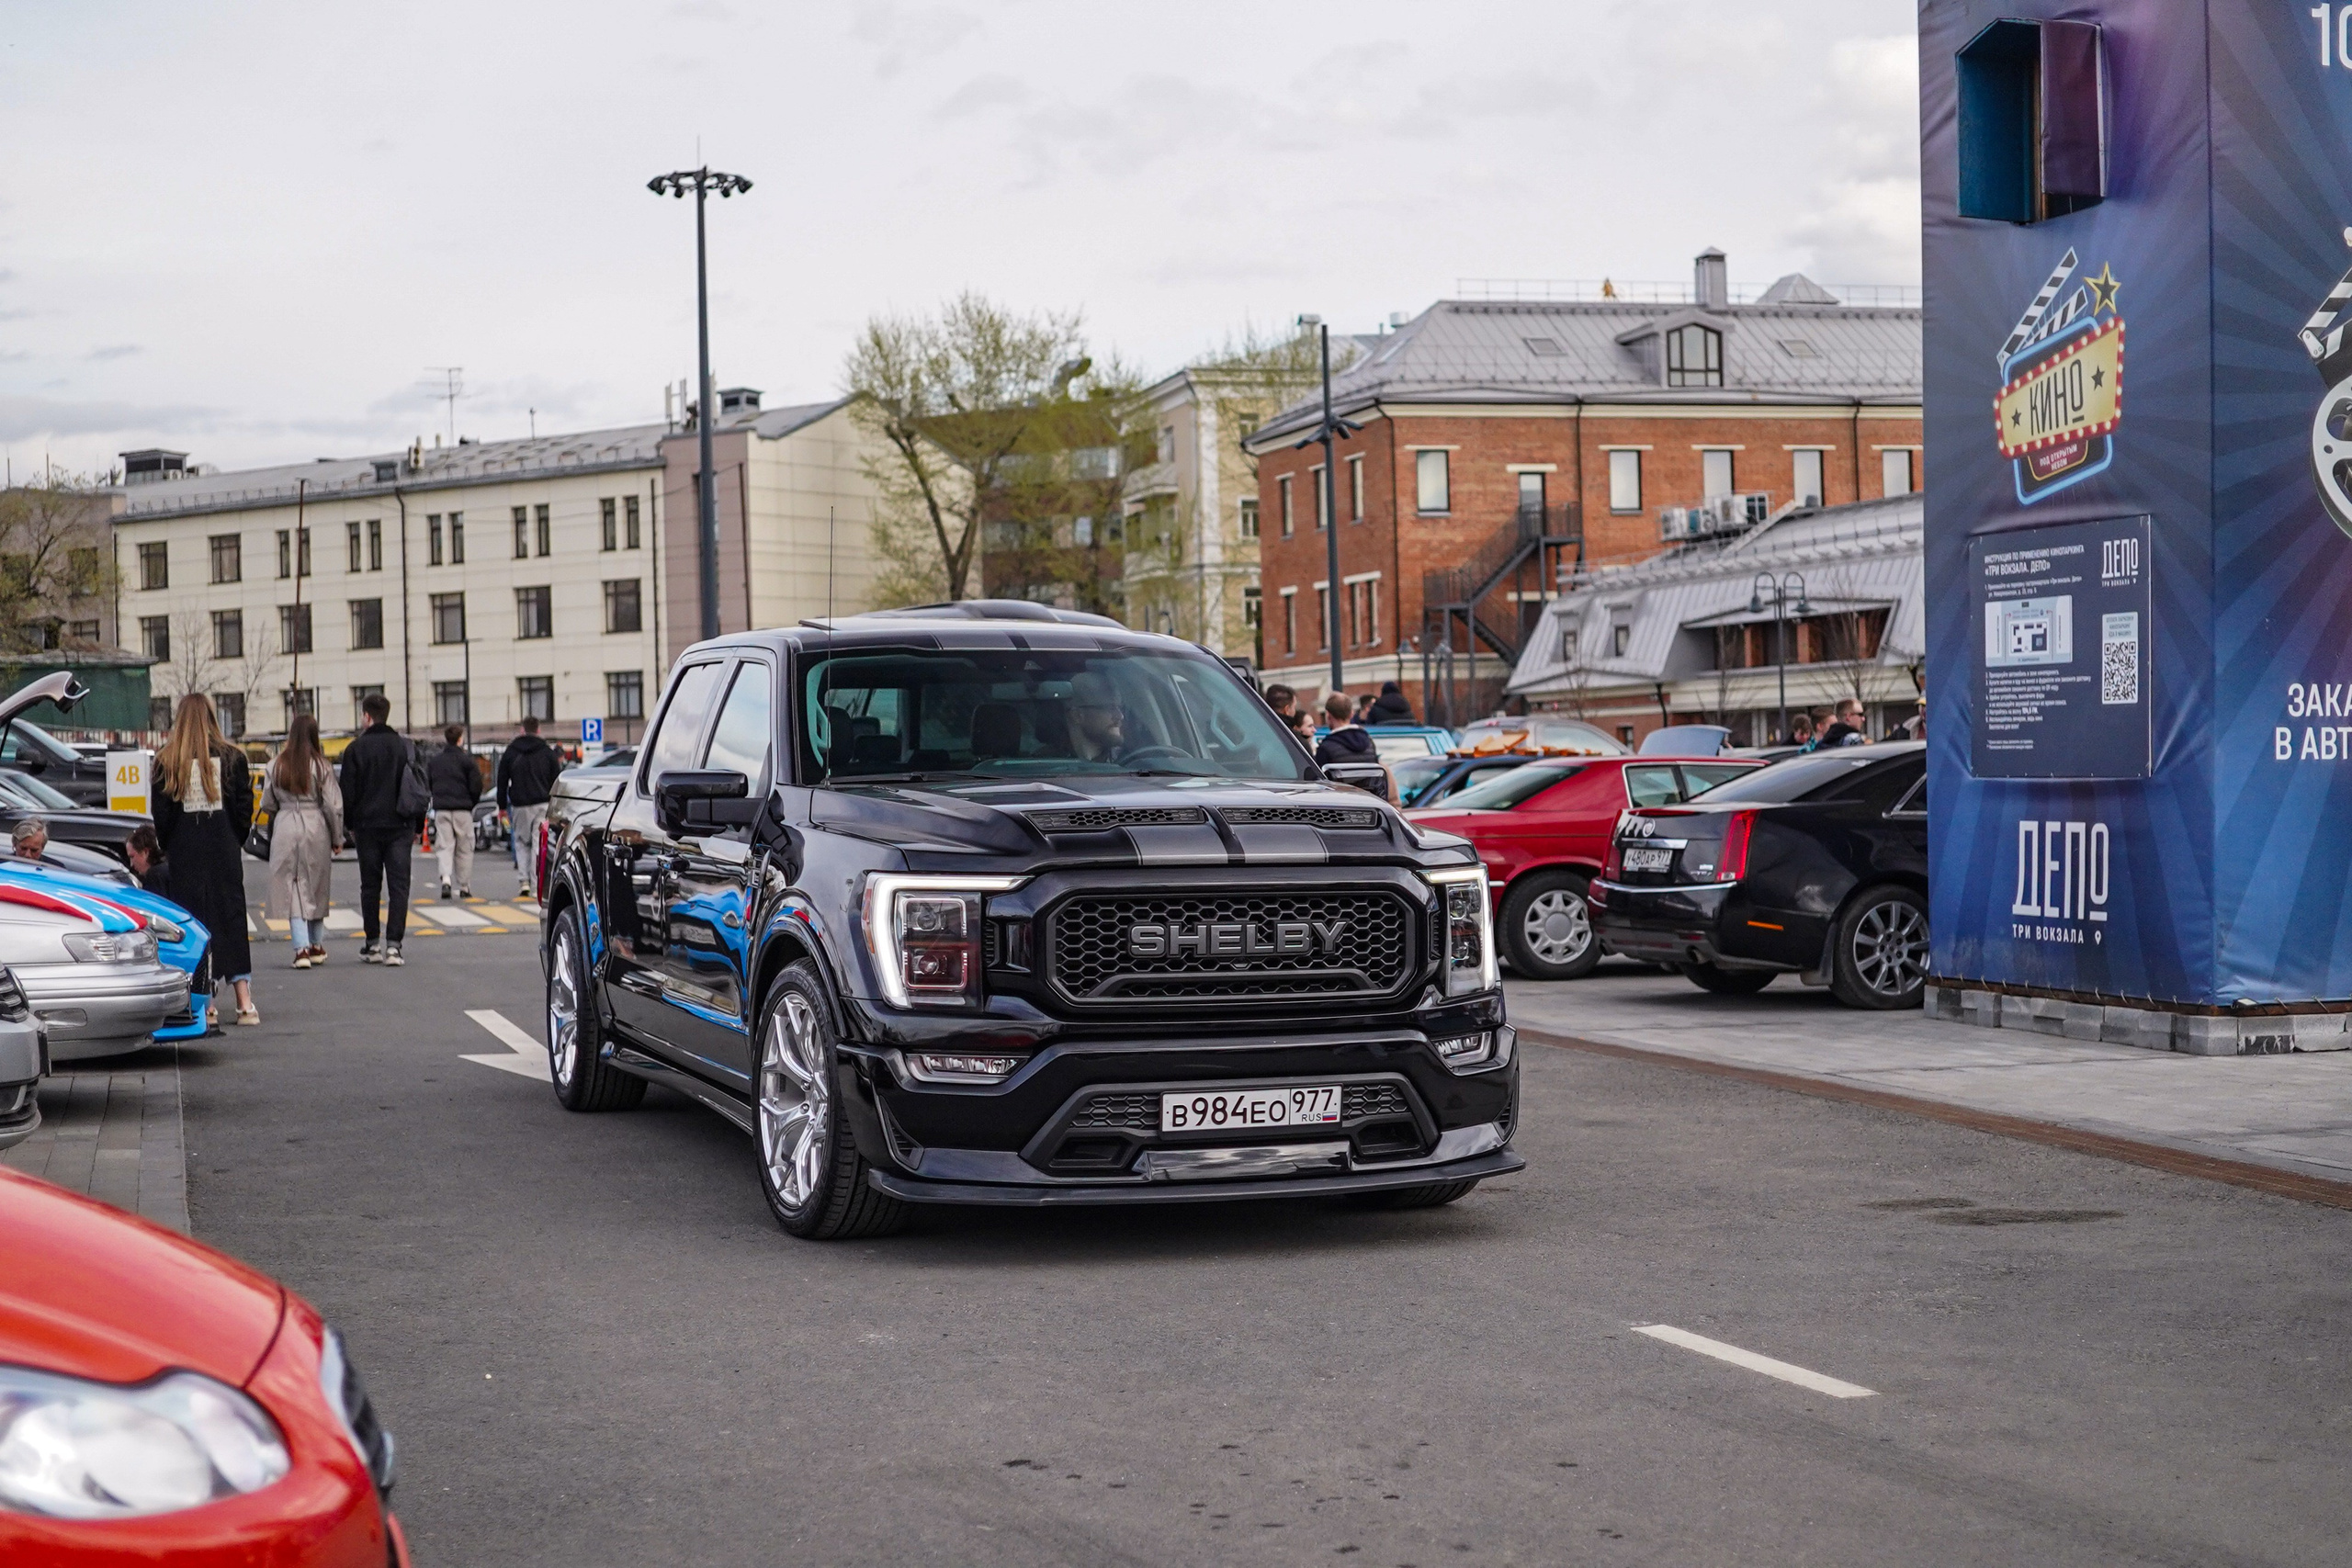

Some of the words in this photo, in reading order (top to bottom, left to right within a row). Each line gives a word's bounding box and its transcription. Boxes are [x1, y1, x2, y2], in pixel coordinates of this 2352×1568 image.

[2030, 359, 2085, 436] КИНО
[2102, 537, 2139, 579] ДЕПО
[2276, 727, 2292, 760] В
[2012, 820, 2109, 921] ДЕПО
[1129, 921, 1348, 957] SHELBY
[2012, 923, 2030, 940] ТРИ
[2036, 925, 2085, 944] ВОКЗАЛА
[1292, 1089, 1334, 1113] 977
[1301, 1113, 1321, 1122] RUS
